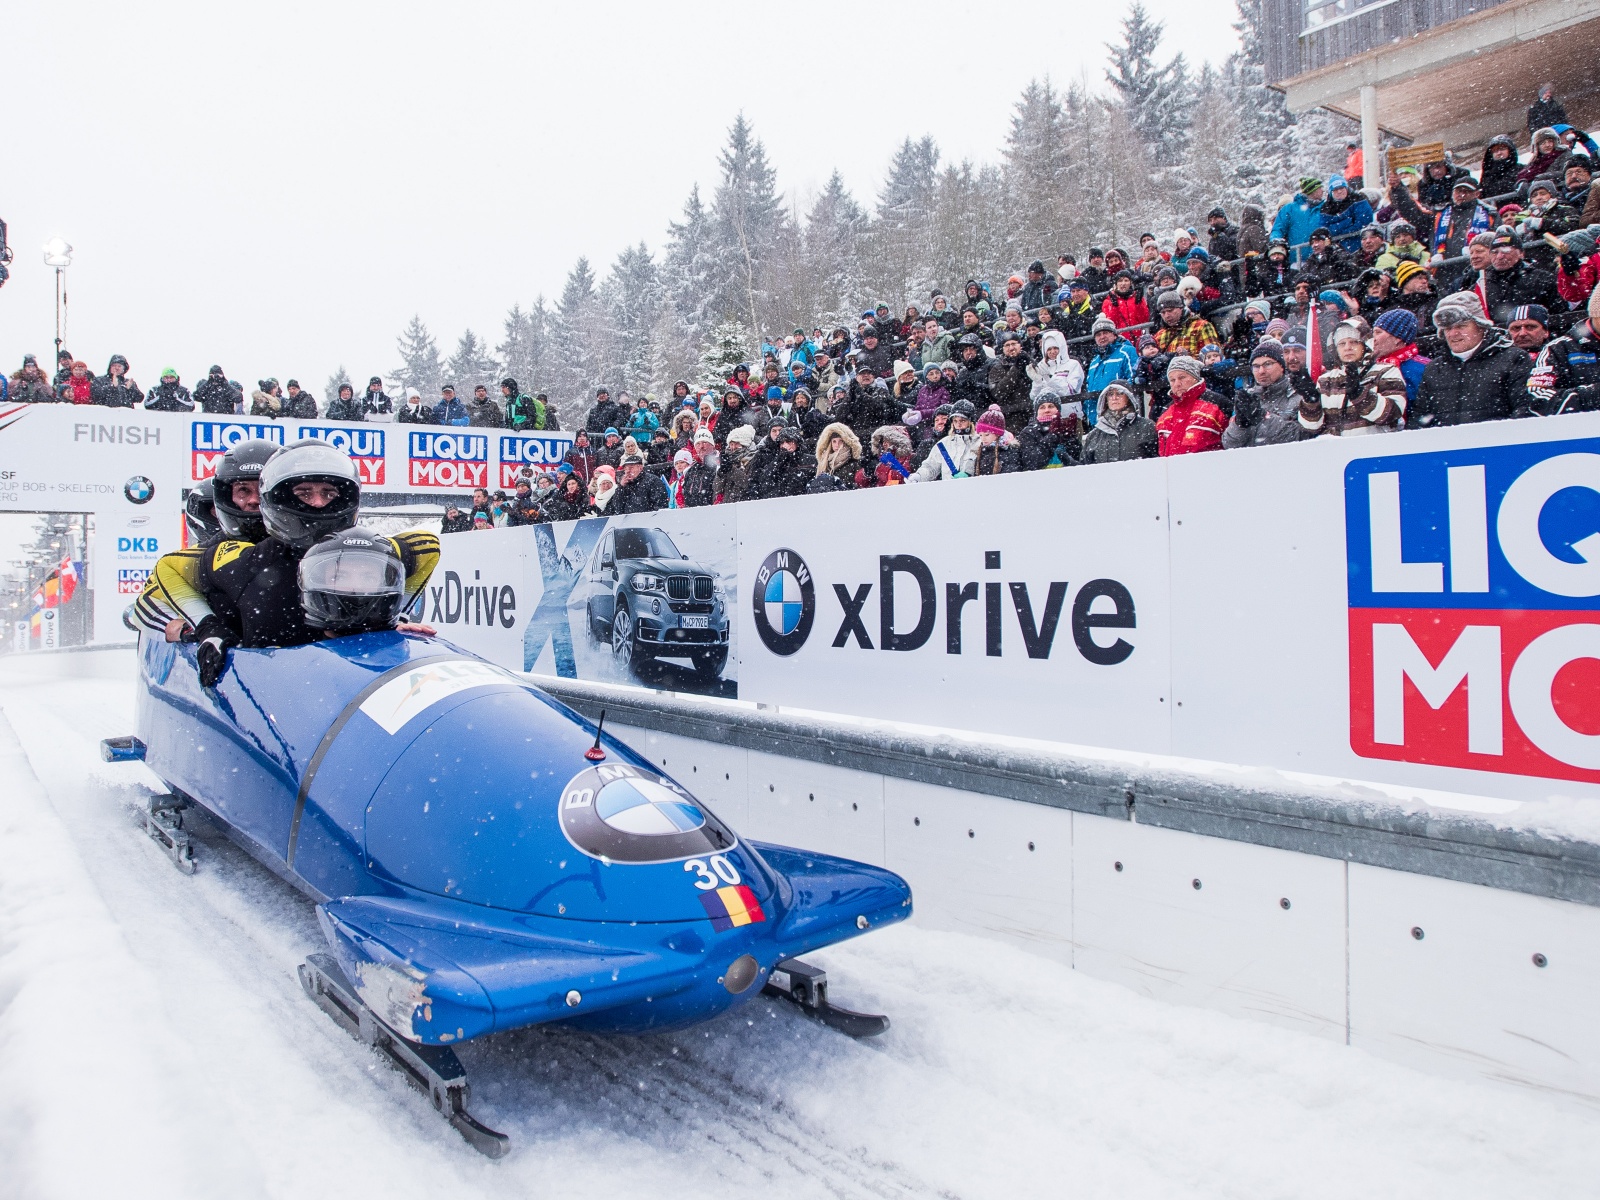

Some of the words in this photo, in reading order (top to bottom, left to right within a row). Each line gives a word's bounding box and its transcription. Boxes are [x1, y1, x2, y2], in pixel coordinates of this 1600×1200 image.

[73, 423, 161, 446] FINISH
[196, 424, 280, 450] LIQUI
[412, 434, 485, 460] LIQUI
[503, 438, 570, 463] LIQUI
[0, 471, 16, 480] SF
[352, 458, 385, 483] LY
[412, 461, 486, 486] MOLY
[0, 492, 18, 502] RG
[22, 482, 47, 492] BOB
[58, 483, 115, 494] SKELETON
[117, 537, 159, 552] DKB
[119, 570, 154, 582] LIQU
[757, 551, 811, 586] BMW
[119, 582, 145, 592] MO
[430, 569, 516, 629] xDrive
[831, 550, 1138, 666] xDrive
[683, 855, 742, 891] 30
